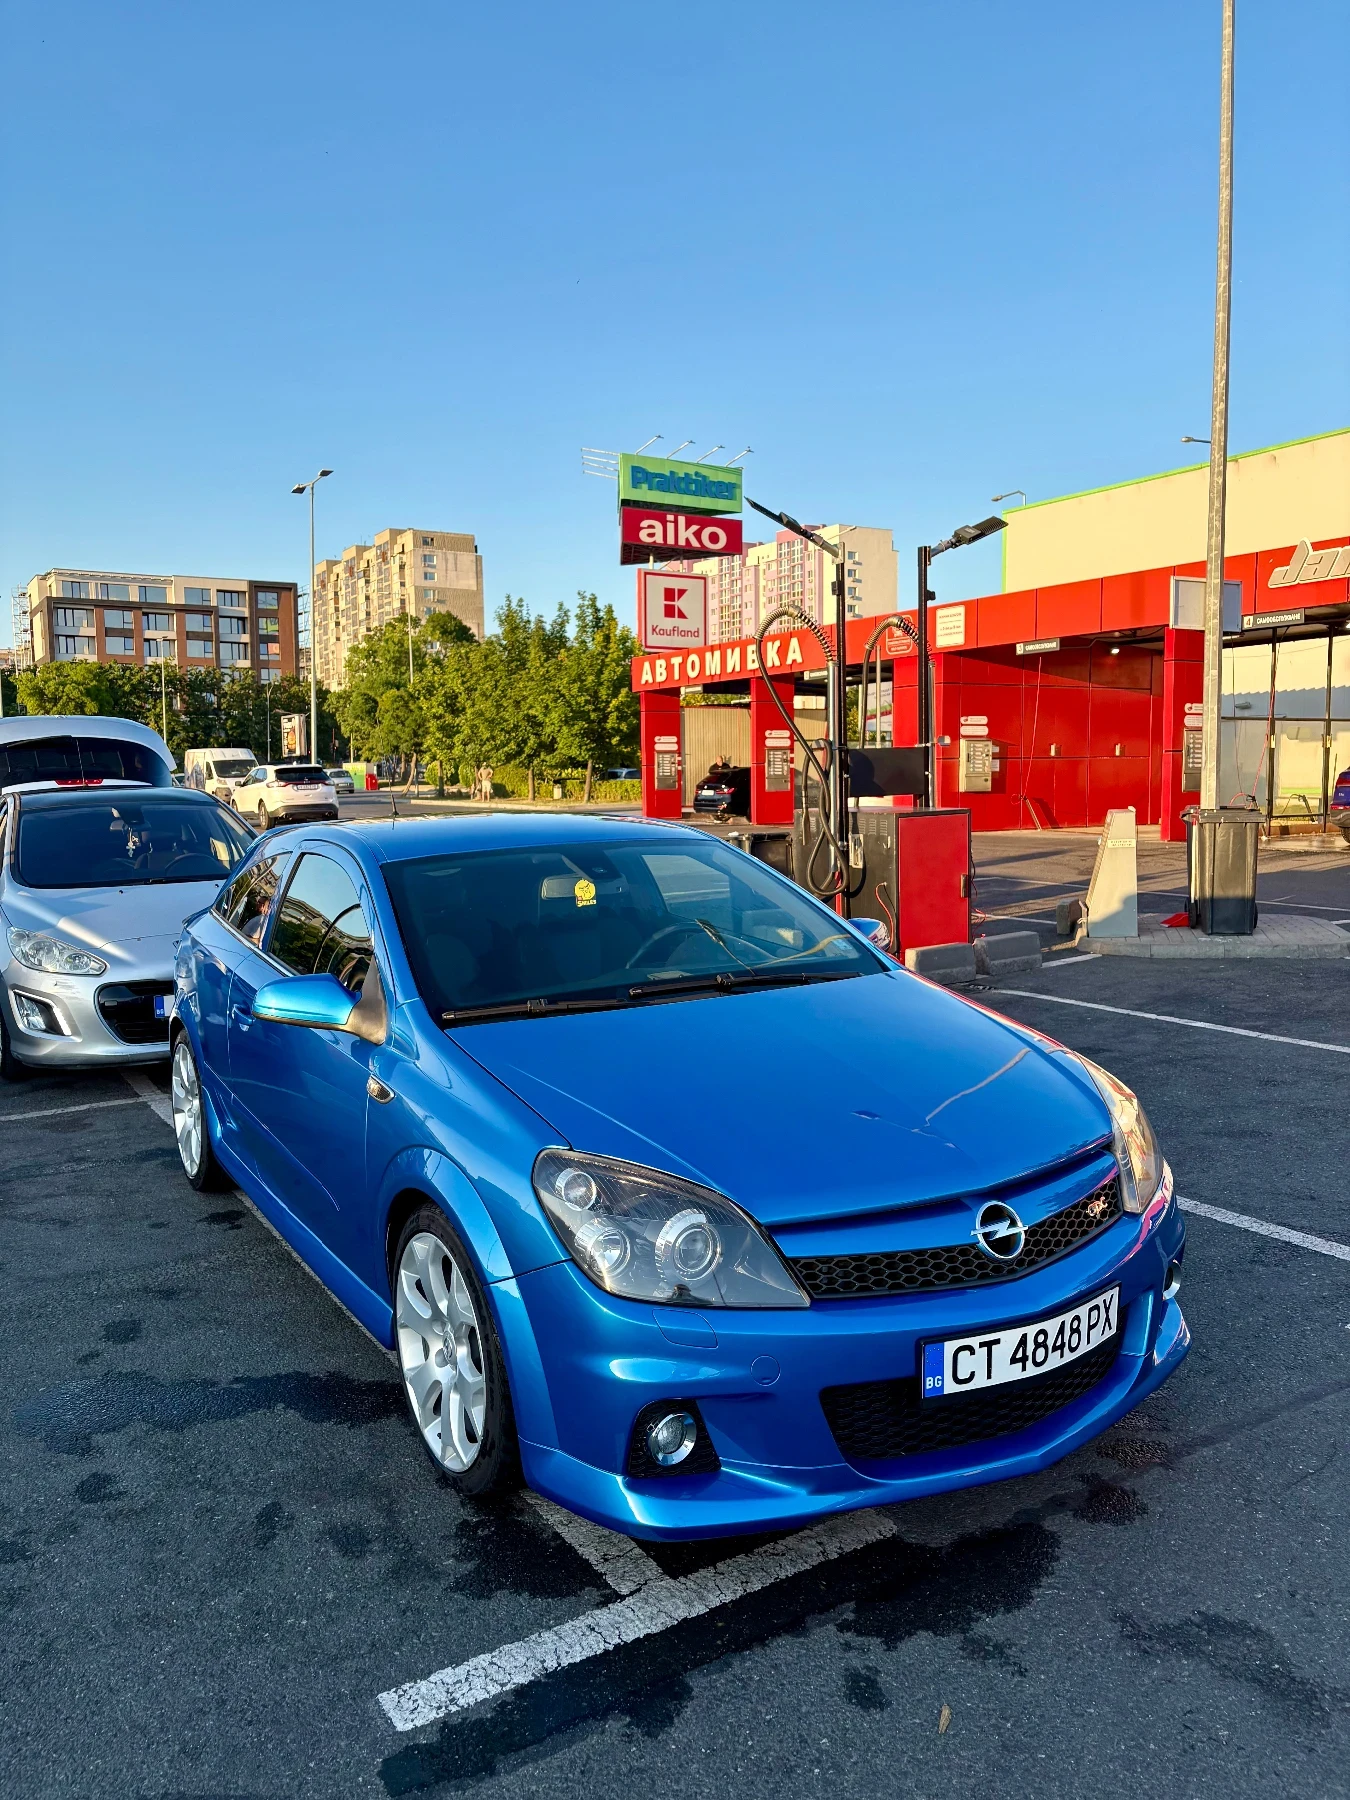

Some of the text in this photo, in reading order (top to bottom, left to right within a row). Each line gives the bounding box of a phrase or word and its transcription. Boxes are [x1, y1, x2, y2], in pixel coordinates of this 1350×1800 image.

[630, 464, 737, 501] Praktiker
[638, 514, 728, 550] aiko
[651, 624, 700, 639] Kaufland
[640, 636, 803, 686] АВТОМИВКА
[1009, 1314, 1082, 1373] 4848
[925, 1375, 943, 1390] BG
